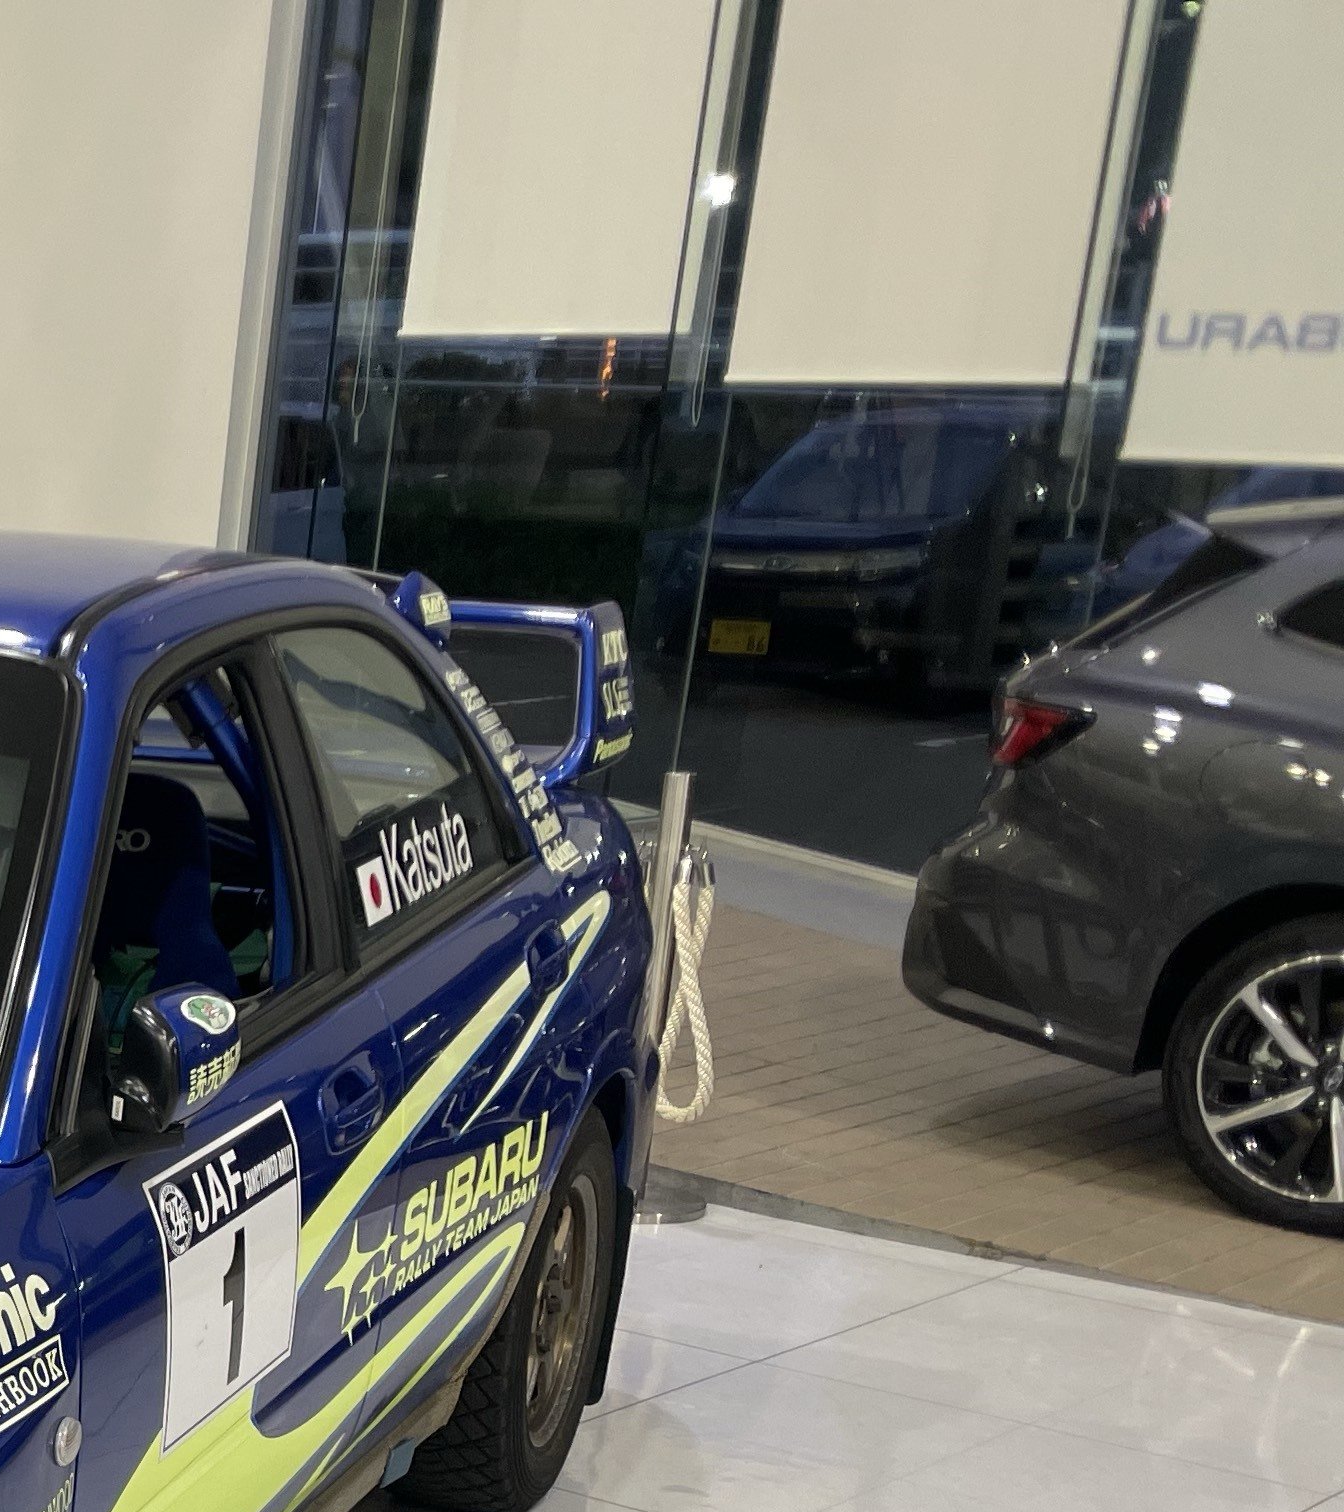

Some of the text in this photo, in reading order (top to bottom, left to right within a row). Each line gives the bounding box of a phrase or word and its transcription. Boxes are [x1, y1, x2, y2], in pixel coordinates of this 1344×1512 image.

[378, 801, 474, 911] Katsuta
[192, 1148, 243, 1234] JAF
[392, 1174, 541, 1296] RALLY TEAM JAPAN
[400, 1110, 550, 1262] SUBARU
[222, 1229, 246, 1386] 1
